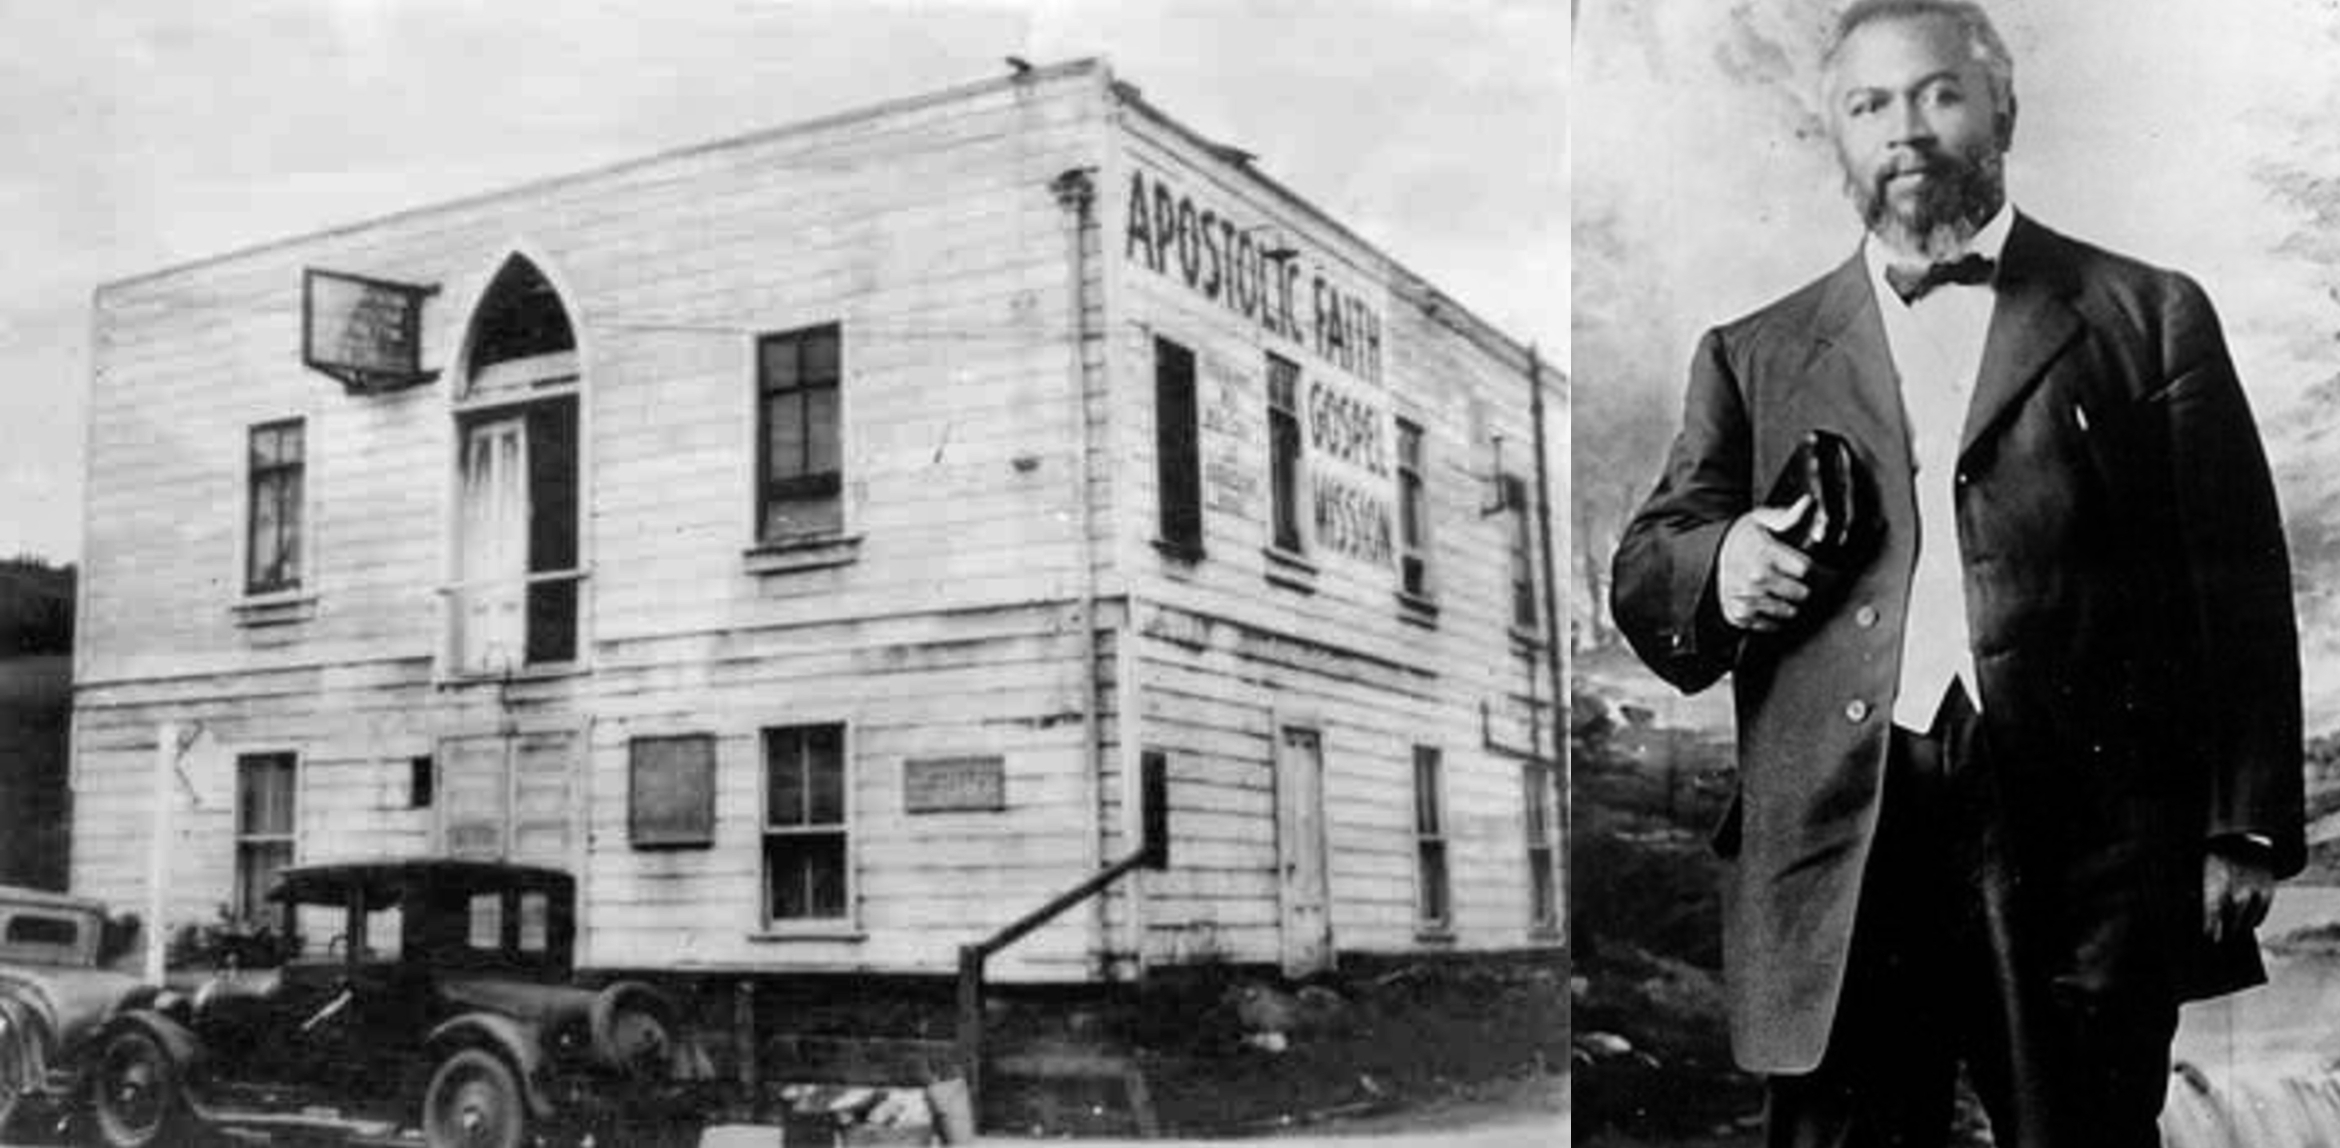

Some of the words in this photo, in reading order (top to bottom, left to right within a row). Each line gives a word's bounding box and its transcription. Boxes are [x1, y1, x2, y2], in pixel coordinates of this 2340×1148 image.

[1126, 170, 1302, 344] APOSTOLIC
[1312, 274, 1382, 389] FAITH
[1310, 381, 1389, 478] GOSPEL
[1313, 472, 1393, 562] MISSION
